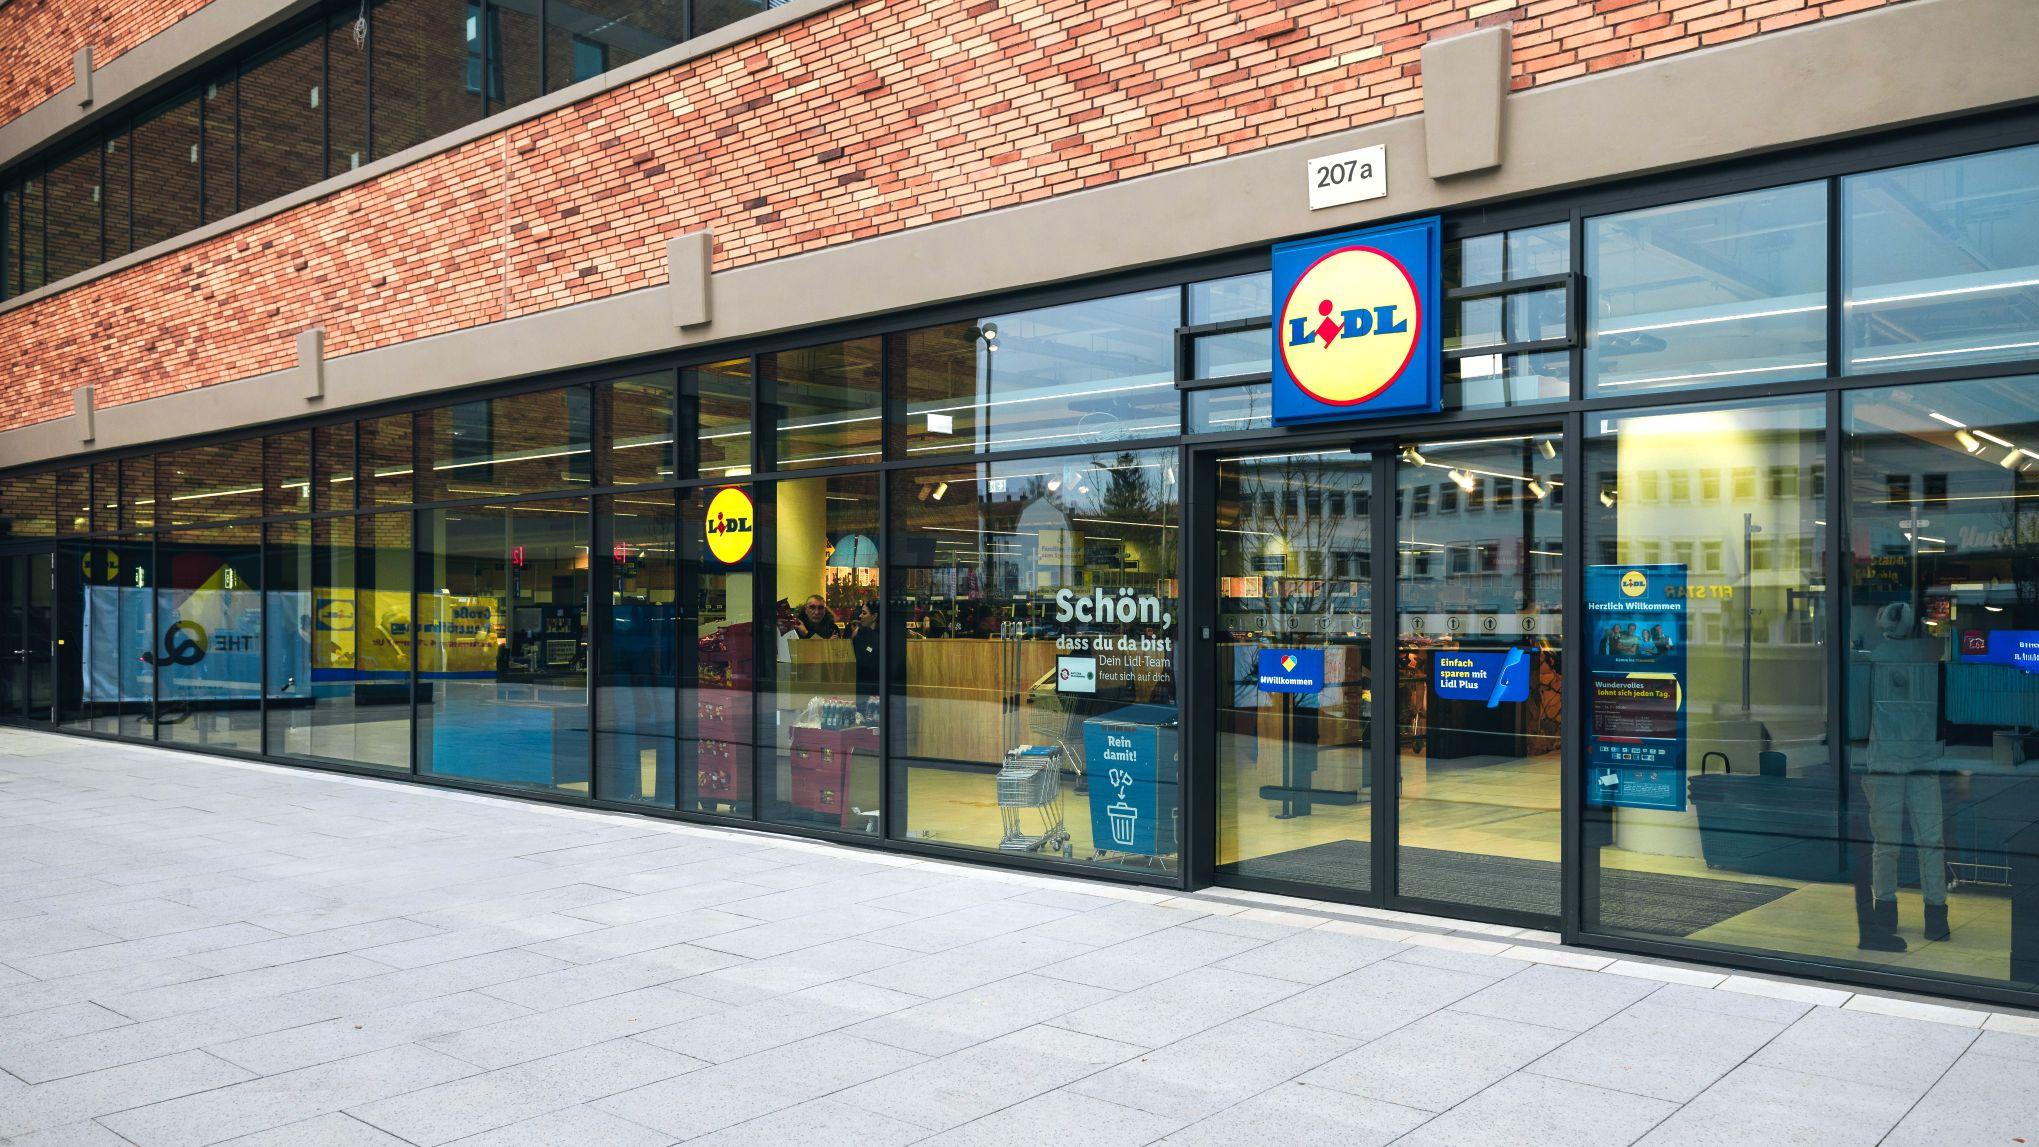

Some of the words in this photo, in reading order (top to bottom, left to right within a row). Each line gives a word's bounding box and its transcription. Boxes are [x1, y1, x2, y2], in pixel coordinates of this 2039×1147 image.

[1056, 588, 1172, 630] Schön,
[1588, 602, 1623, 610] Herzlich
[1626, 602, 1681, 610] Willkommen
[1056, 634, 1089, 650] dass
[1093, 634, 1113, 651] du
[1117, 634, 1137, 651] da
[1141, 634, 1172, 651] bist
[1099, 655, 1121, 666] Dein
[1124, 655, 1171, 668] Lidl-Team
[1440, 658, 1473, 667] Einfach
[1099, 671, 1118, 681] freut
[1119, 671, 1136, 681] sich
[1137, 671, 1151, 681] auf
[1152, 672, 1171, 682] dich
[1440, 670, 1470, 678] sparen
[1472, 669, 1487, 679] mit
[1440, 679, 1457, 688] Lidl
[1458, 680, 1479, 689] Plus
[1595, 681, 1644, 689] Wundervolles
[1618, 689, 1632, 697] sich
[1633, 690, 1654, 698] jeden
[1655, 691, 1671, 699] Tag.
[1107, 735, 1131, 748] Rein
[1103, 749, 1137, 761] damit!
